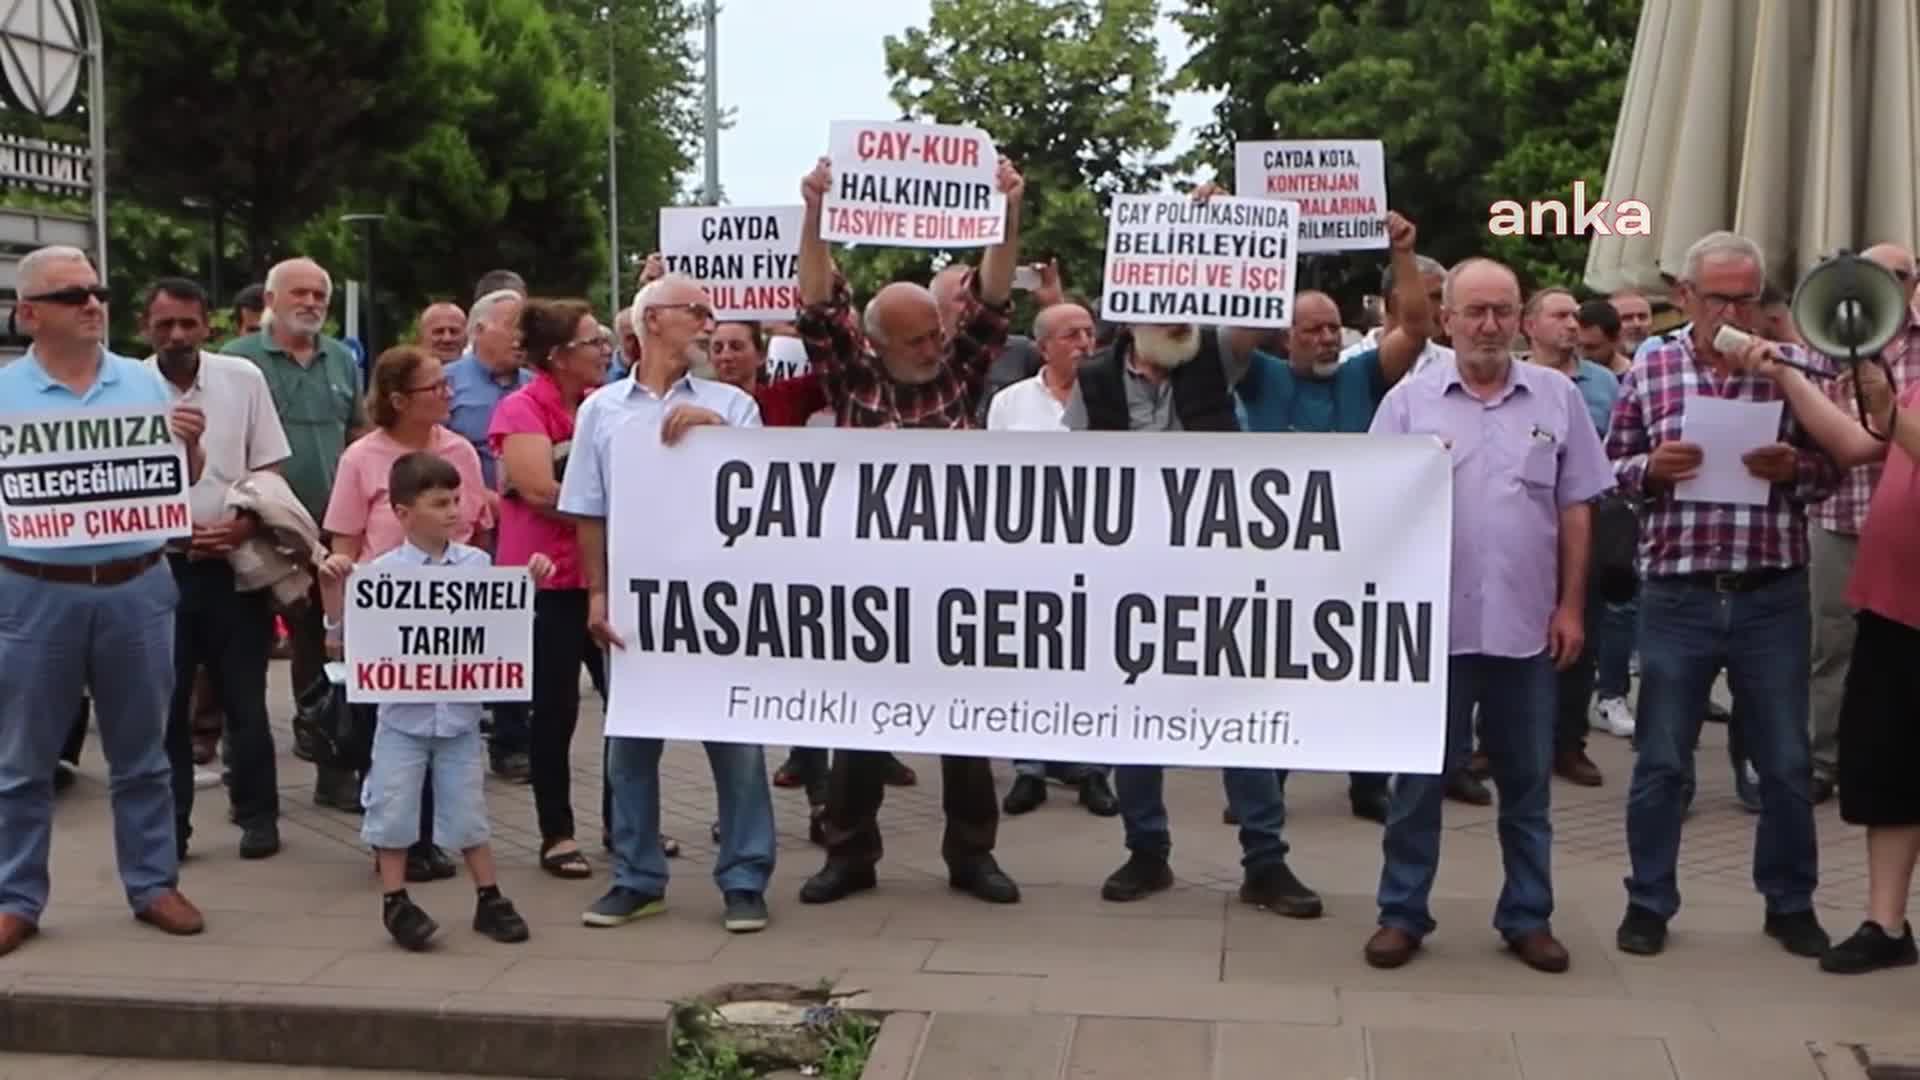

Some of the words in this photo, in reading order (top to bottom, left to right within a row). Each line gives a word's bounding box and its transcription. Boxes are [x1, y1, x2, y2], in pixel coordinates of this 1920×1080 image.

[857, 130, 980, 167] ÇAY-KUR
[841, 172, 991, 211] HALKINDIR
[1266, 173, 1360, 193] KONTENJAN
[827, 204, 907, 238] TASVİYE
[913, 211, 1001, 240] EDİLMEZ
[1117, 202, 1153, 226] ÇAY
[1297, 196, 1377, 215] MALARINA
[701, 216, 780, 244] ÇAYDA
[1114, 228, 1288, 259] BELİRLEYİCİ
[1298, 217, 1385, 239] RİLMELİDİR
[666, 254, 743, 279] TABAN
[753, 249, 800, 279] FİYA
[1112, 257, 1198, 287] ÜRETİCİ
[1206, 263, 1233, 287] VE
[1241, 261, 1287, 292] İŞÇİ
[1109, 291, 1284, 319] OLMALIDIR
[0, 414, 171, 459] ÇAYIMIZA
[2, 459, 176, 500] GELECEĞİMİZE
[7, 507, 75, 539] SAHİP
[85, 503, 188, 539] ÇIKALIM
[715, 459, 836, 547] ÇAY
[855, 462, 1136, 546] KANUNU
[1161, 467, 1341, 552] YASA
[356, 572, 527, 614] SÖZLEŞMELİ
[398, 626, 485, 655] TARIM
[629, 578, 911, 664] TASARISI
[936, 573, 1087, 671] GERİ
[1114, 579, 1433, 685] ÇEKİLSİN
[357, 656, 524, 691] KÖLELİKTİR
[728, 685, 858, 725] Fındıklı
[871, 698, 936, 736] çay
[949, 697, 1118, 738] üreticileri
[1133, 706, 1300, 751] insiyatifi.
